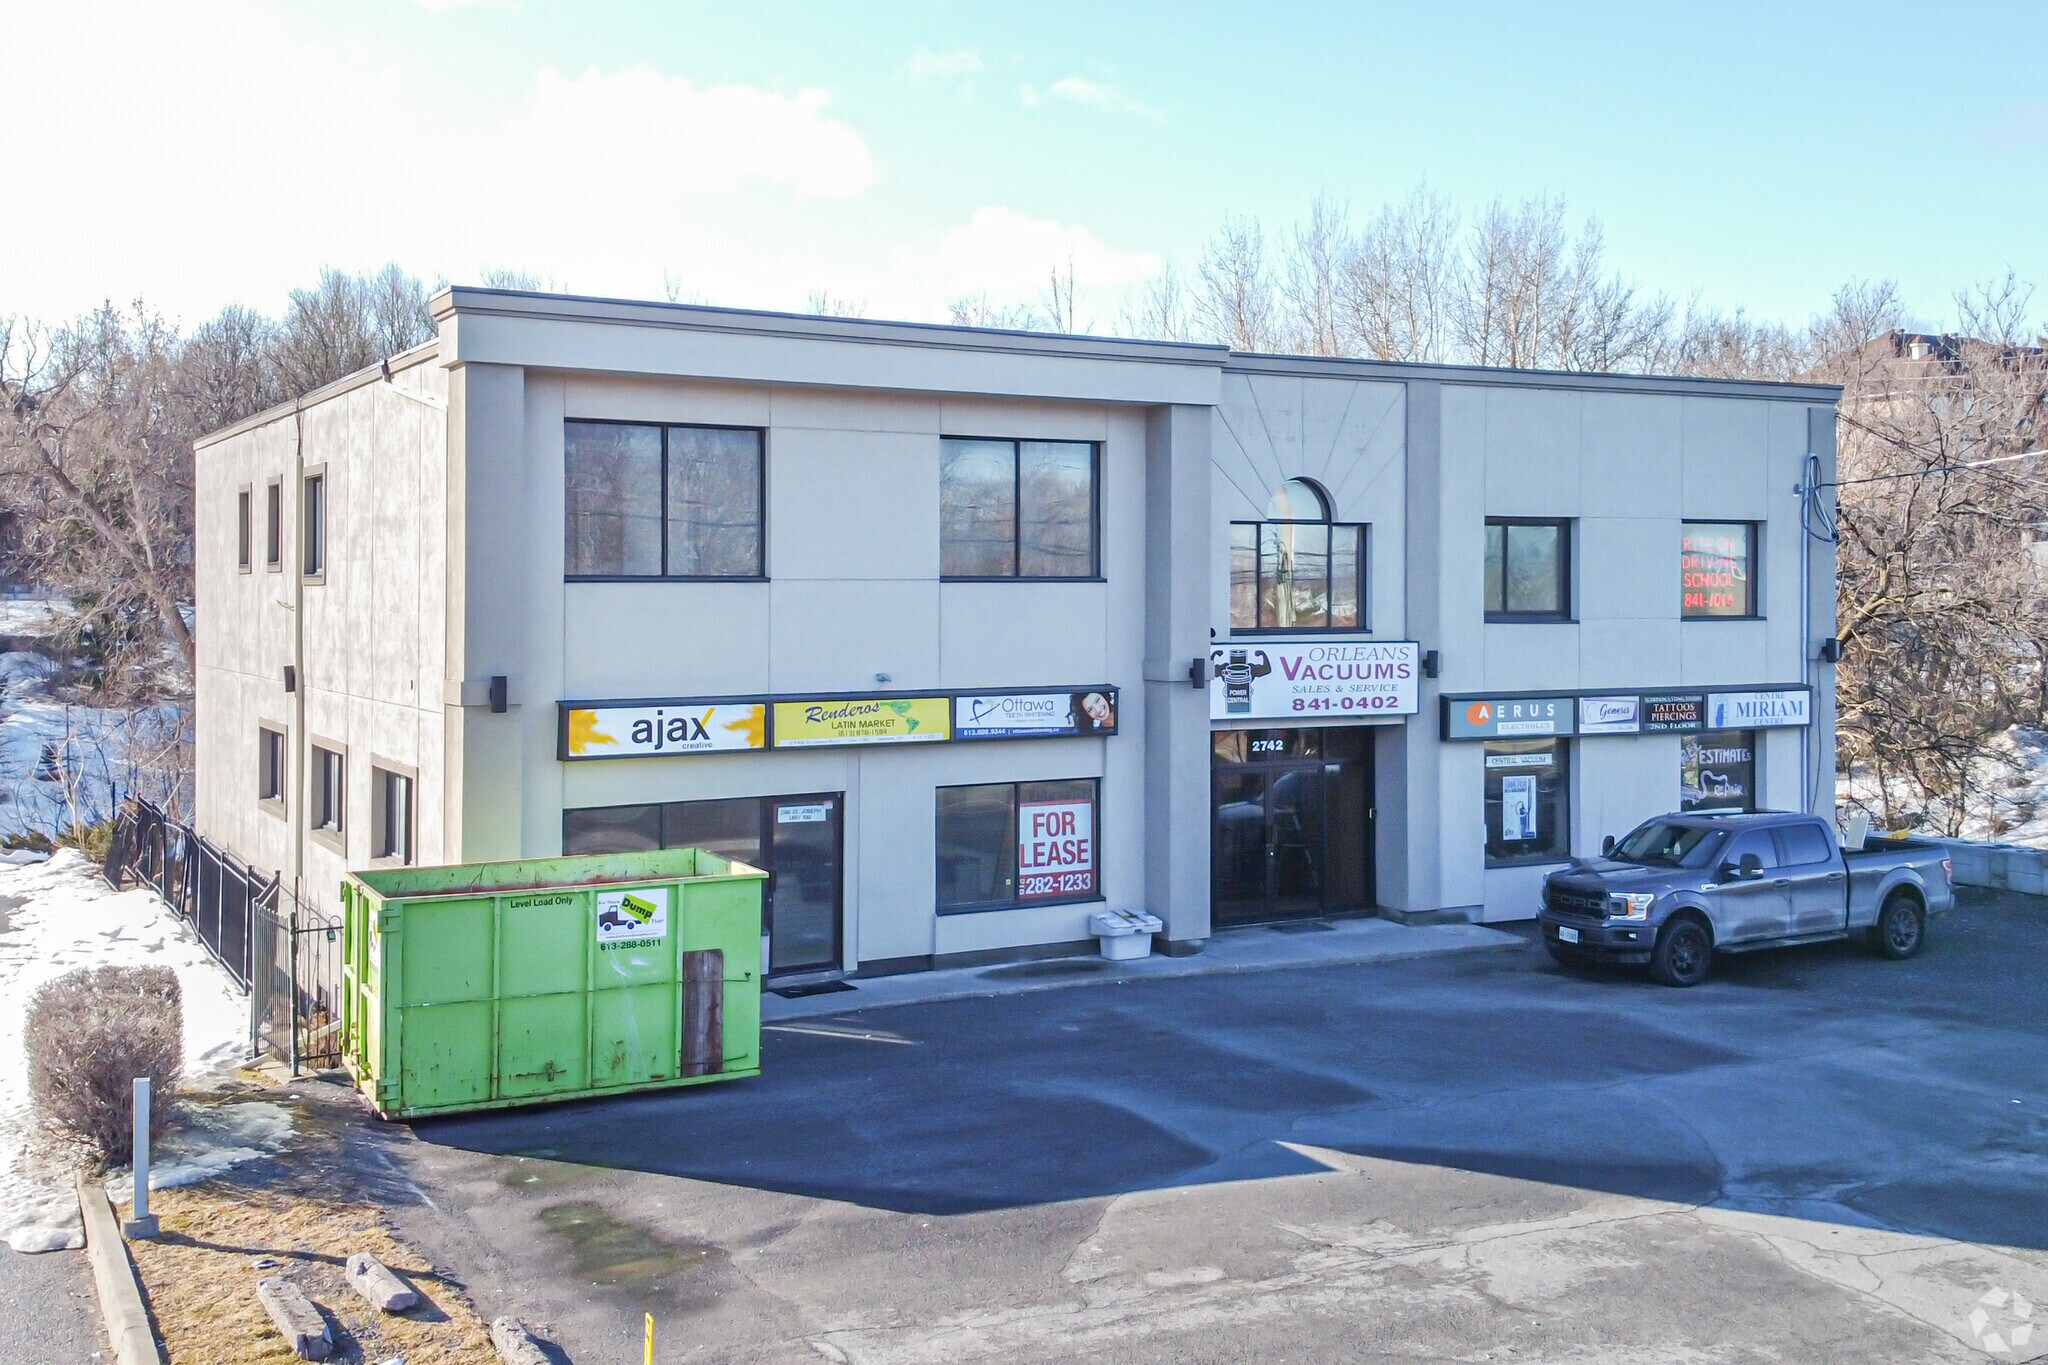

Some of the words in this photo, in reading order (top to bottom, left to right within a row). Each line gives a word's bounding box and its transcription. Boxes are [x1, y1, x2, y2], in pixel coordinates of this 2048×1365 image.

[1682, 555, 1738, 569] DRIVING
[1683, 573, 1734, 588] SCHOOL
[1308, 646, 1410, 662] ORLEANS
[1279, 656, 1411, 681] VACUUMS
[1292, 685, 1331, 694] SALES
[1335, 685, 1343, 693] &
[1349, 683, 1399, 693] SERVICE
[1001, 698, 1054, 712] Ottawa
[1291, 695, 1399, 711] 841-0402
[1653, 703, 1695, 712] TATTOOS
[1736, 701, 1804, 718] MIRIAM
[805, 702, 881, 724] Renderos
[1478, 703, 1555, 719] AERUS
[1600, 703, 1630, 720] Genesis
[1651, 711, 1697, 721] PIERCINGS
[631, 707, 715, 750] ajax
[831, 720, 857, 729] LATIN
[858, 719, 895, 728] MARKET
[1500, 722, 1551, 730] ELECTROLUX
[1252, 740, 1284, 751] 2742
[1491, 757, 1518, 765] CENTRAL
[1520, 756, 1546, 764] VACUUM
[1032, 811, 1076, 838] FOR
[1020, 838, 1089, 868] LEASE
[1025, 872, 1091, 895] 282-1233
[510, 898, 532, 909] Level
[533, 897, 552, 907] Load
[555, 896, 573, 907] Only
[621, 897, 653, 919] Dump
[600, 939, 661, 951] 613-288-0511
